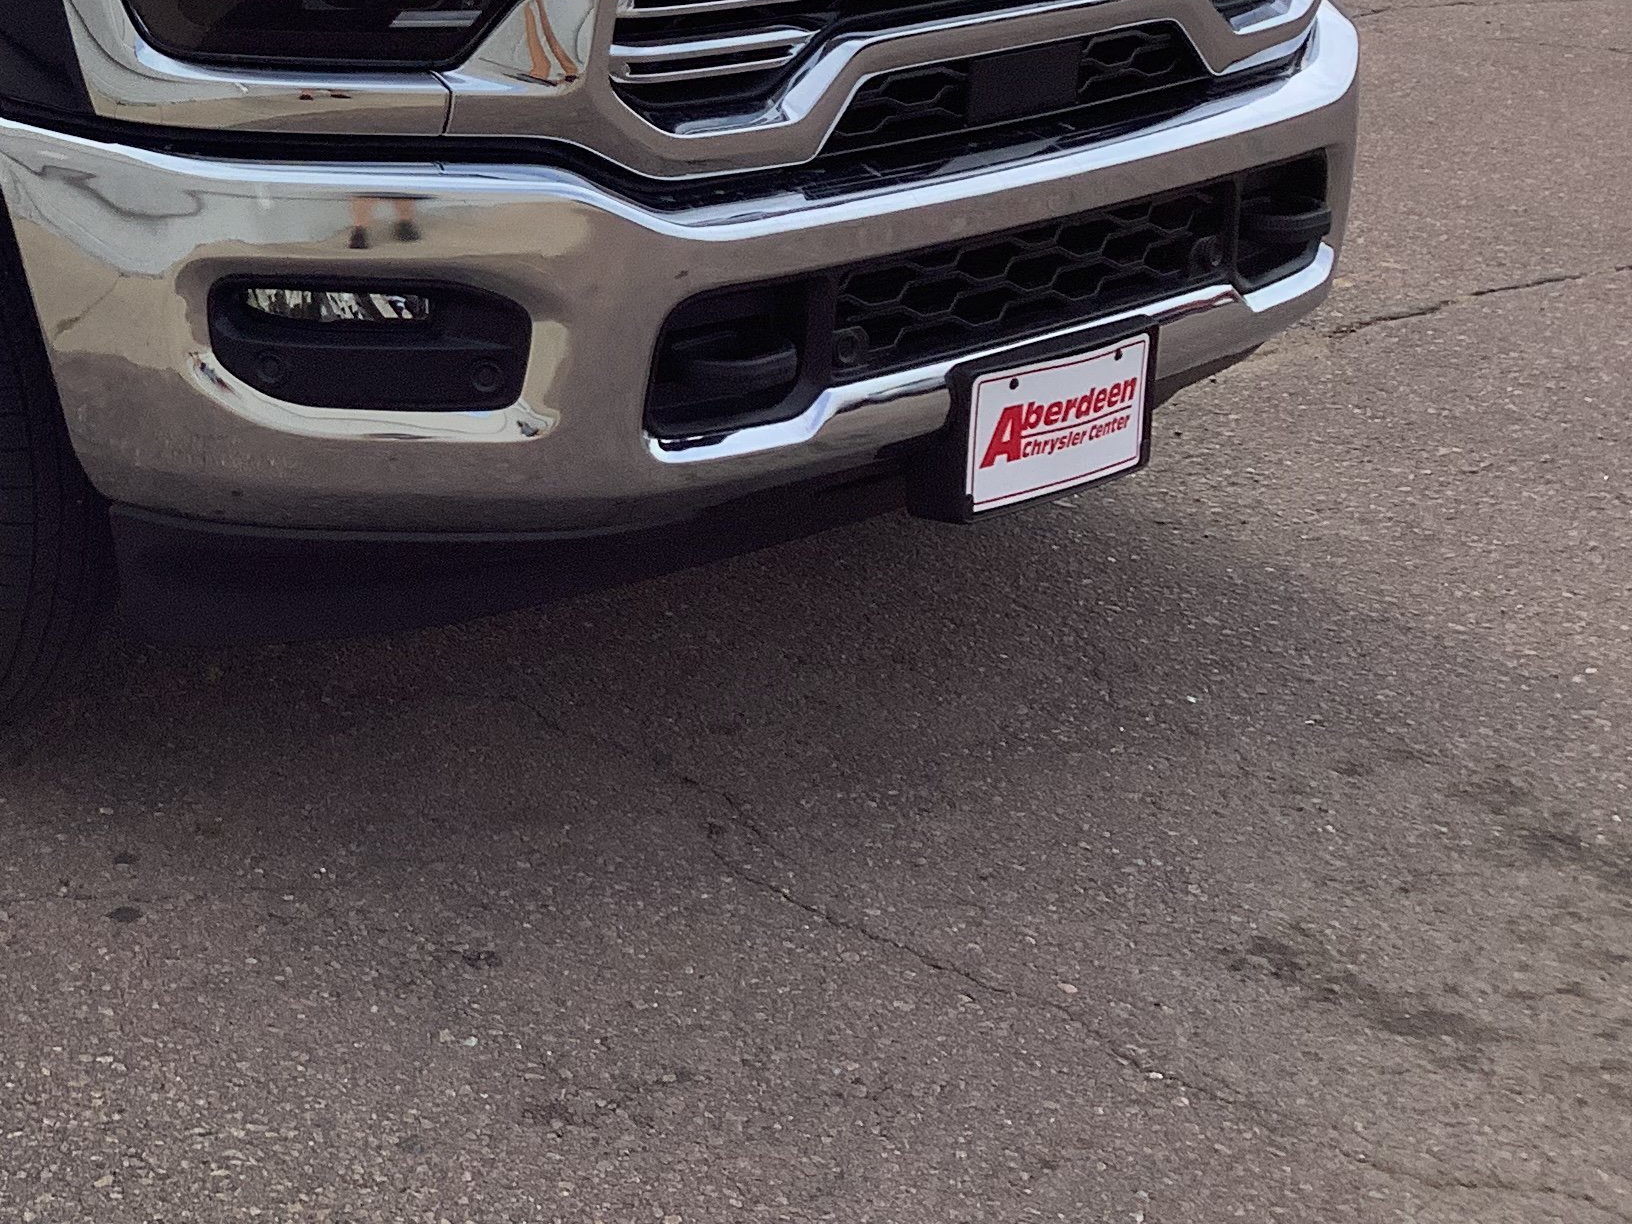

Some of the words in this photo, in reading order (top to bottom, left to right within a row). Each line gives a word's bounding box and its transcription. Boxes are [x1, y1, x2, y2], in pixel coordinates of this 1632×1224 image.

[979, 377, 1137, 469] Aberdeen
[1022, 429, 1087, 458] Chrysler
[1088, 415, 1130, 441] Center
